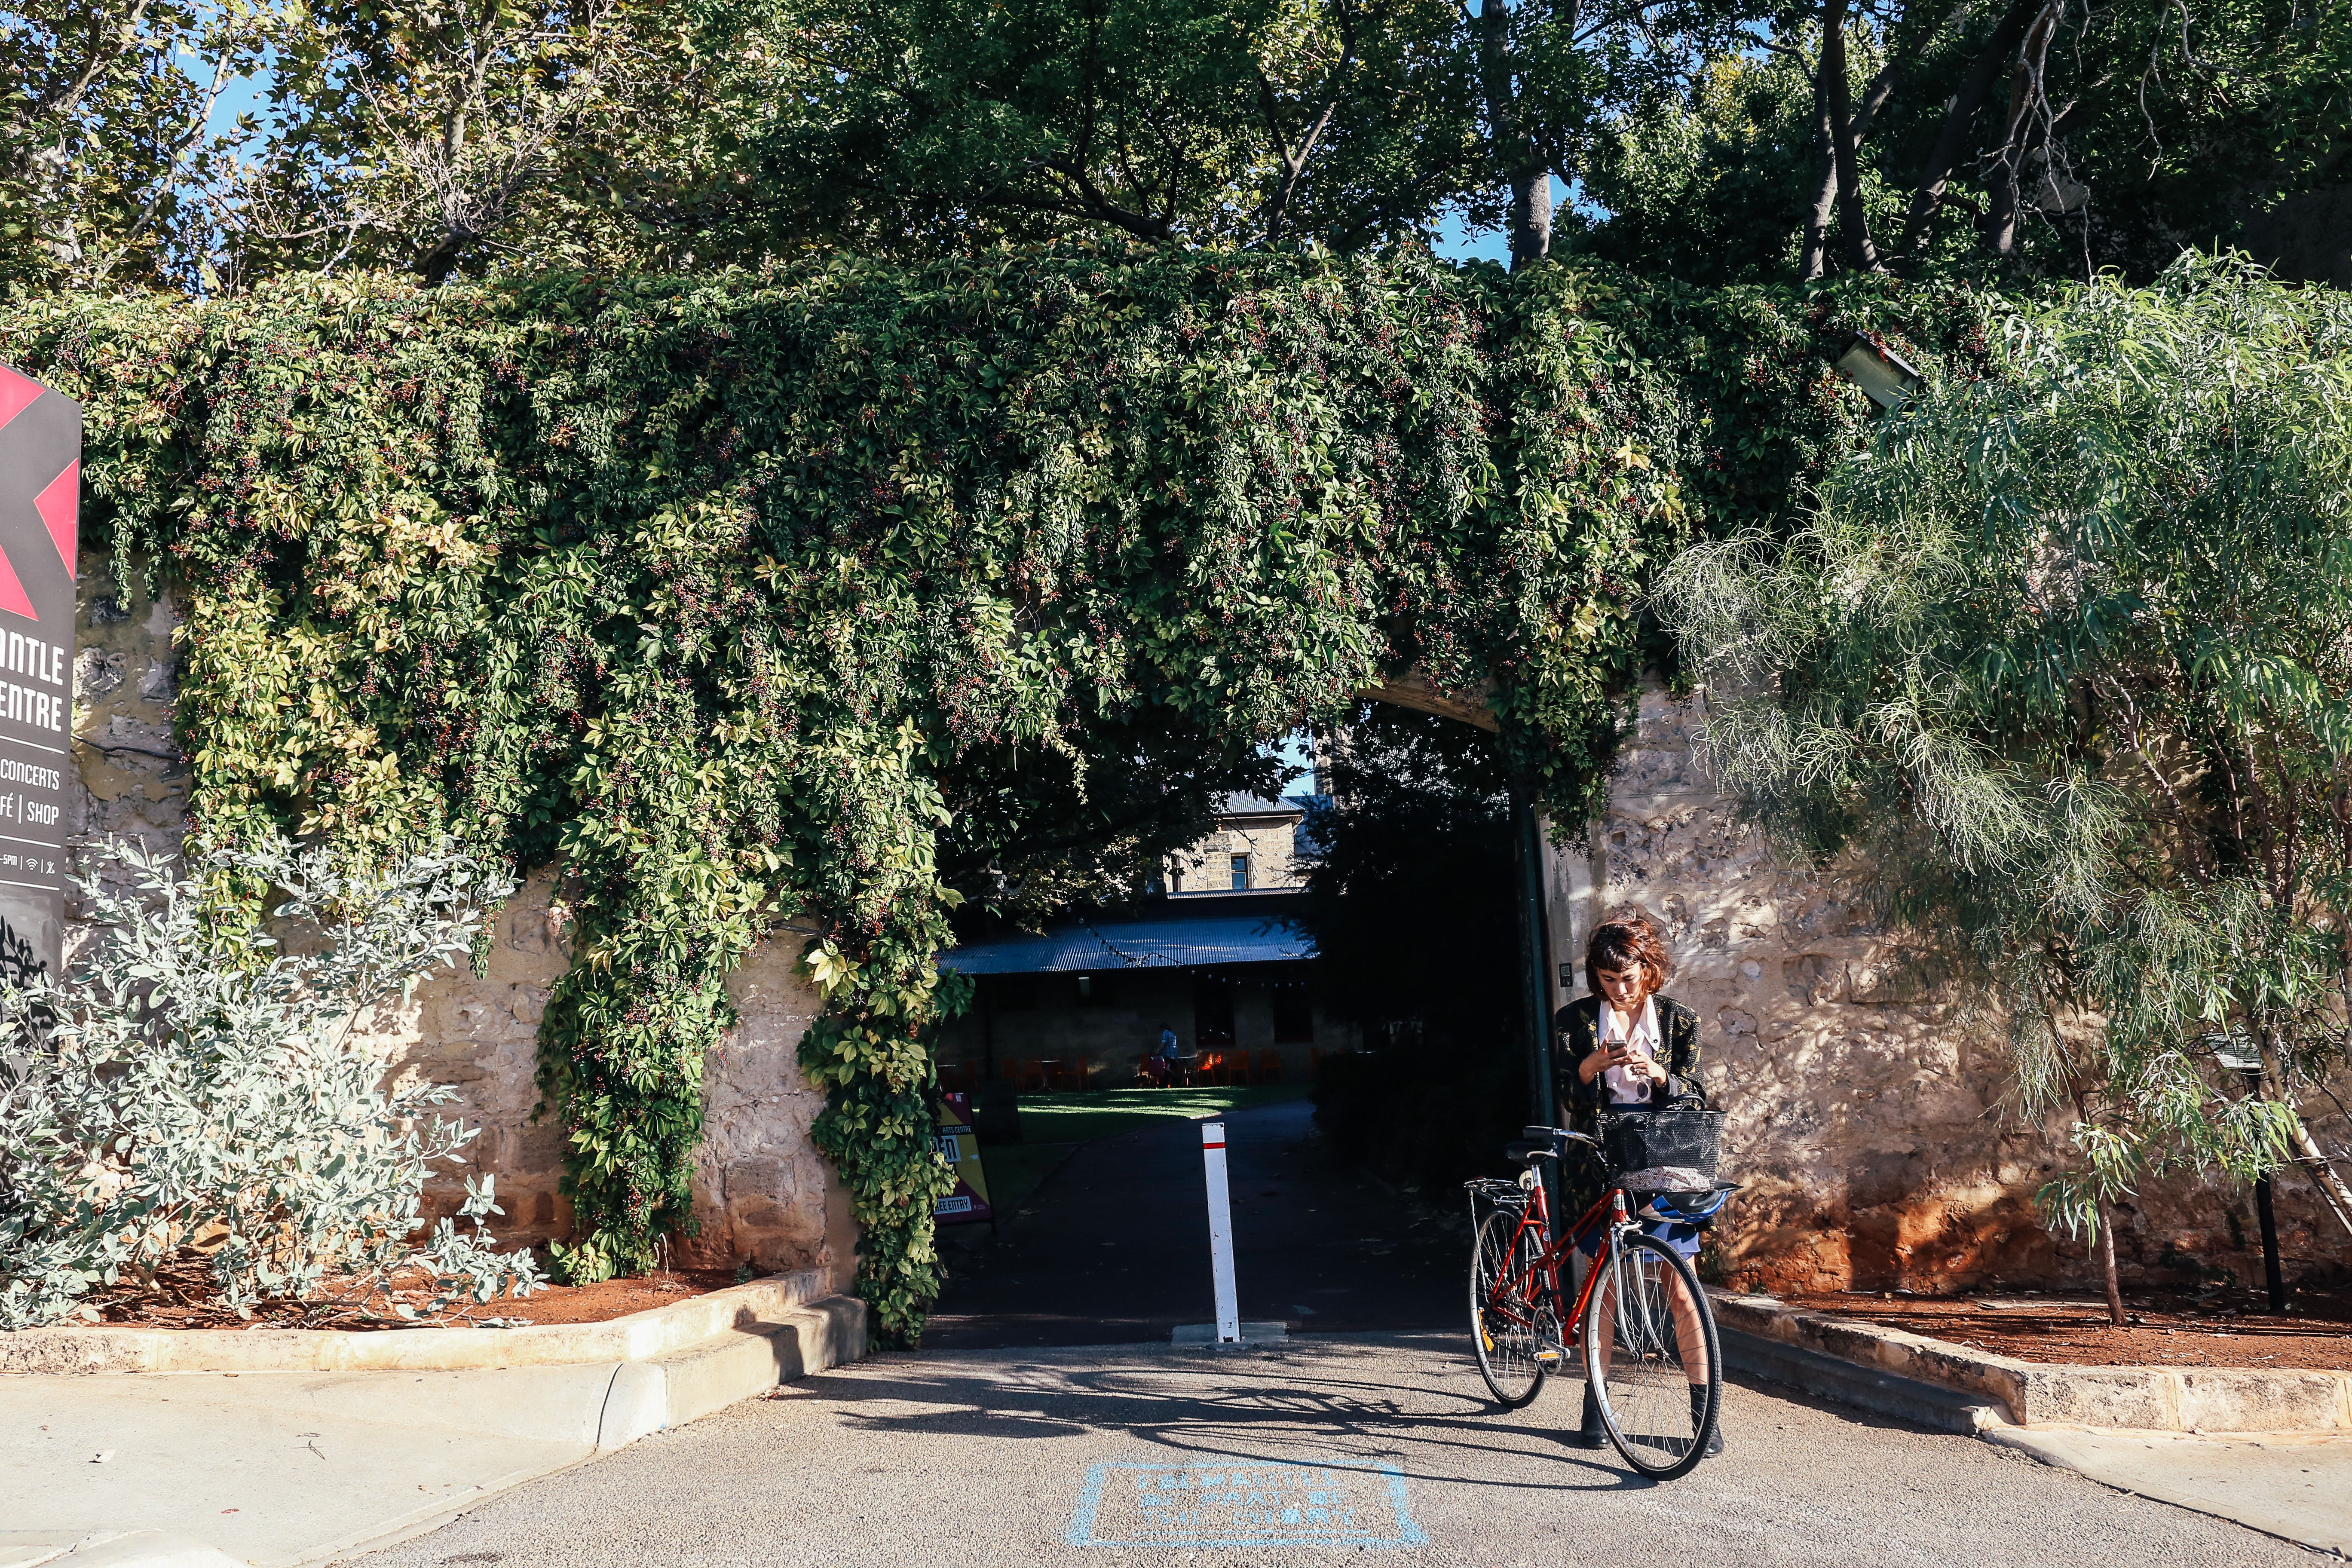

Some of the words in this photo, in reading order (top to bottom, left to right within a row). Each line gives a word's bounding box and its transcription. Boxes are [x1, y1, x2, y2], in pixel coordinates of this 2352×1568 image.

[0, 758, 60, 790] CONCERTS
[27, 801, 59, 826] SHOP
[935, 1201, 947, 1212] REE
[947, 1198, 968, 1210] ENTRY
